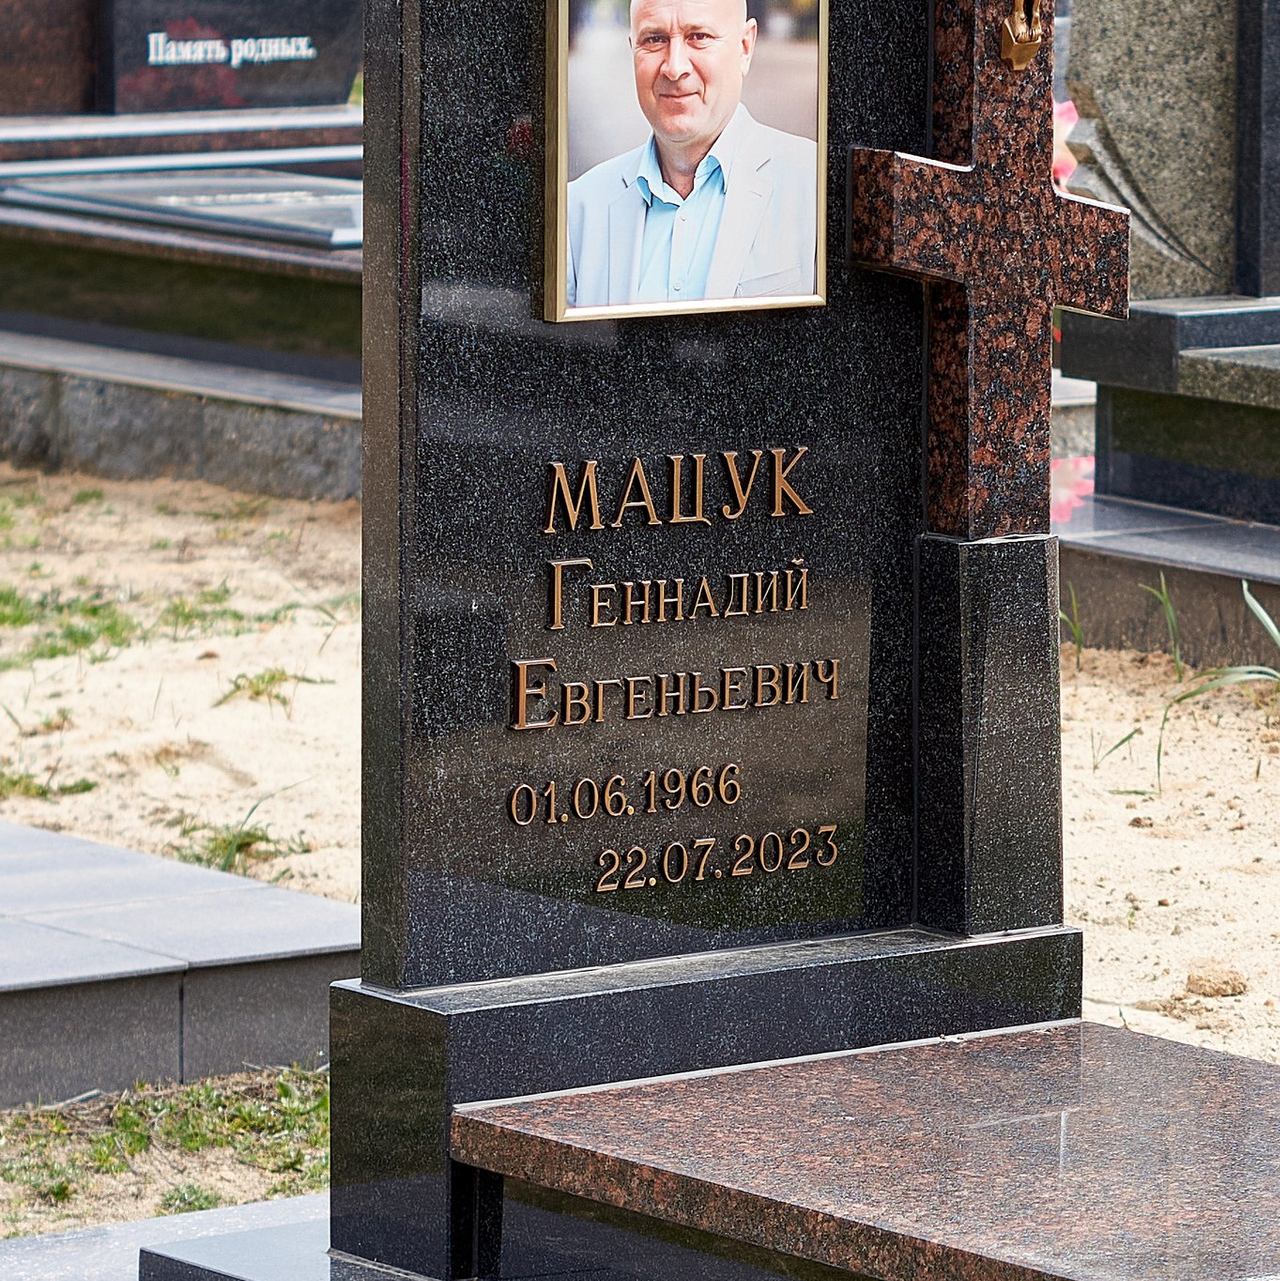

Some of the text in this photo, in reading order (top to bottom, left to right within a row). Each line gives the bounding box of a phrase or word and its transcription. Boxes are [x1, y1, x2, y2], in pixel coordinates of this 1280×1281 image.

[148, 32, 317, 68] Память родных.
[542, 446, 814, 535] МАЦУК
[510, 763, 742, 826] 01.06.1966
[596, 824, 840, 892] 22.07.2023
